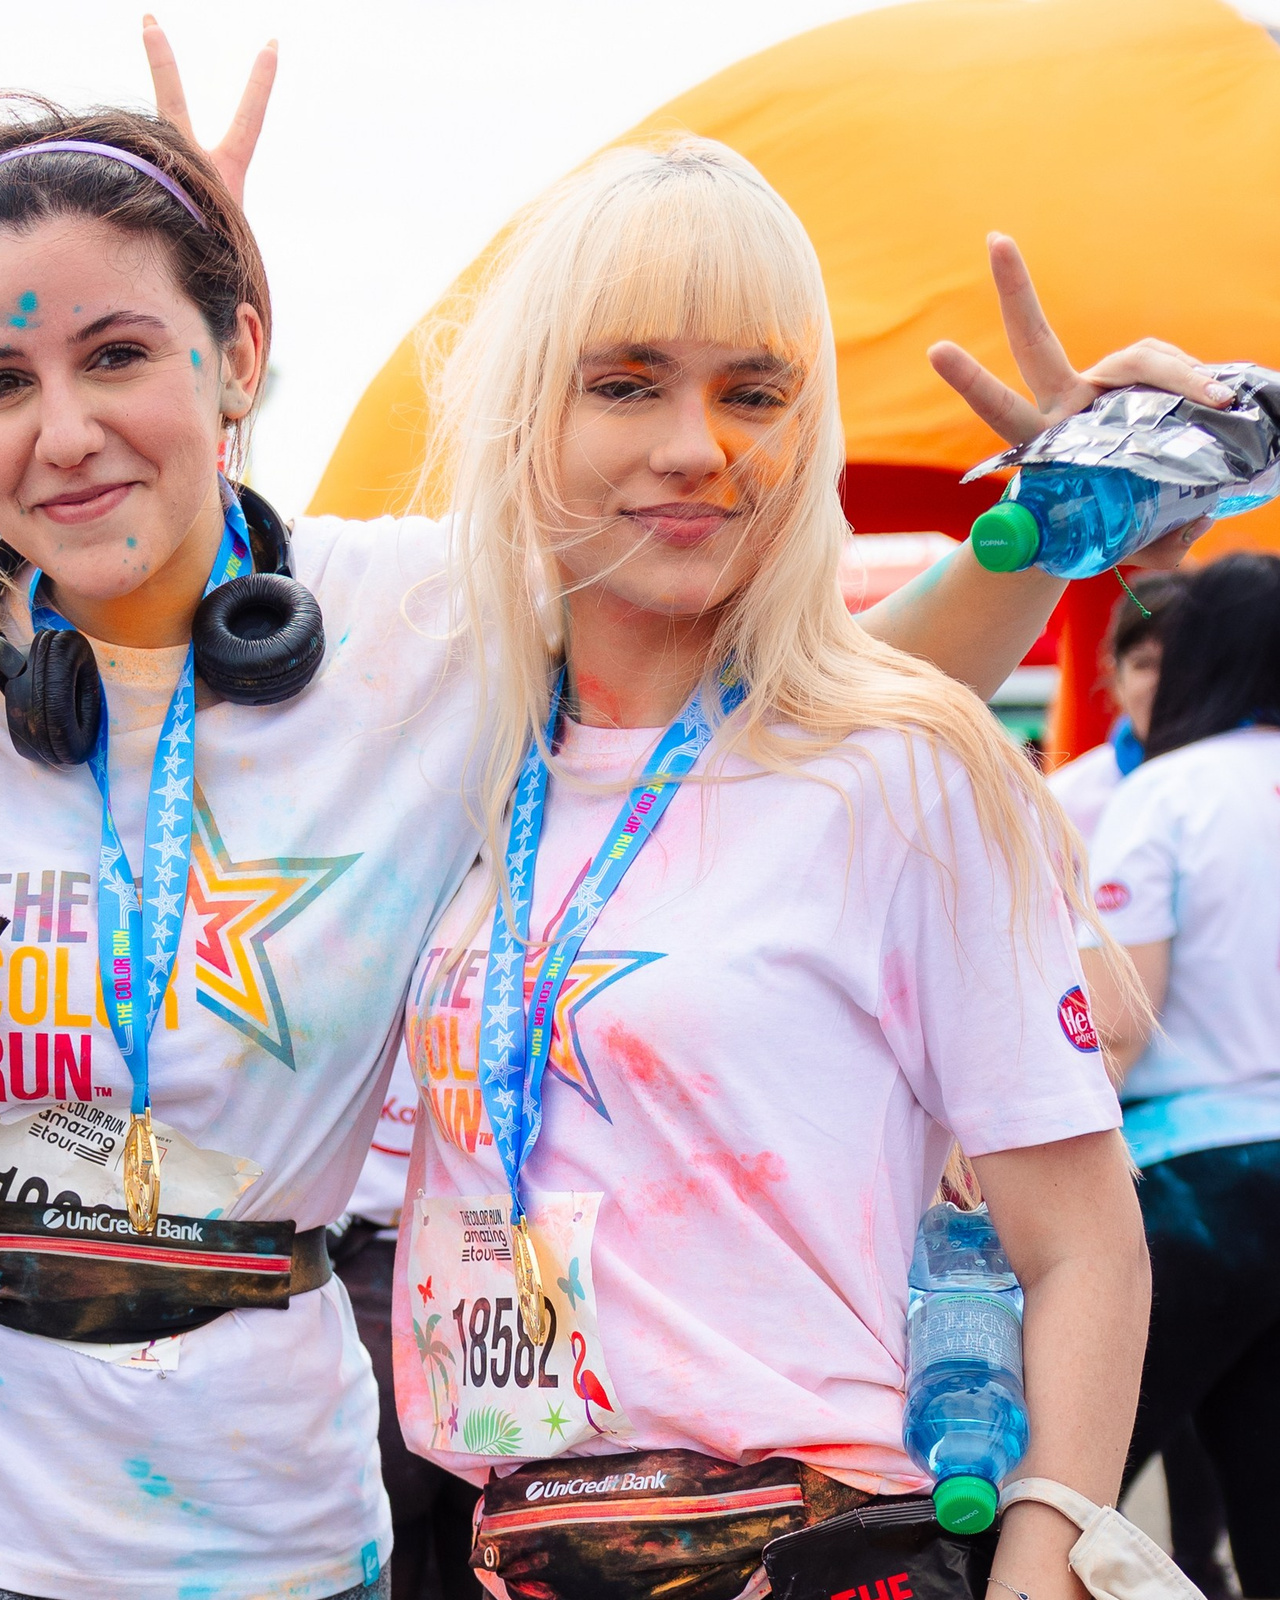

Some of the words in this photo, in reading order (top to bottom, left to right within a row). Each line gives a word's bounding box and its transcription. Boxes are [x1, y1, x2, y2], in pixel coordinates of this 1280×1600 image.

[623, 793, 657, 834] COLOR
[608, 833, 634, 860] RUN
[113, 930, 131, 957] RUN
[113, 958, 133, 1000] COLOR
[546, 955, 565, 979] THE
[116, 1002, 133, 1027] THE
[534, 981, 554, 1026] COLOR
[531, 1028, 543, 1056] RUN
[39, 1109, 116, 1153] amazing
[41, 1127, 77, 1152] tour
[157, 1218, 203, 1242] Bank
[460, 1210, 471, 1226] THE
[469, 1209, 489, 1226] COLOR
[463, 1227, 508, 1247] amazing
[452, 1296, 558, 1388] 18582
[544, 1474, 619, 1498] UniCredit
[620, 1470, 667, 1491] Bank
